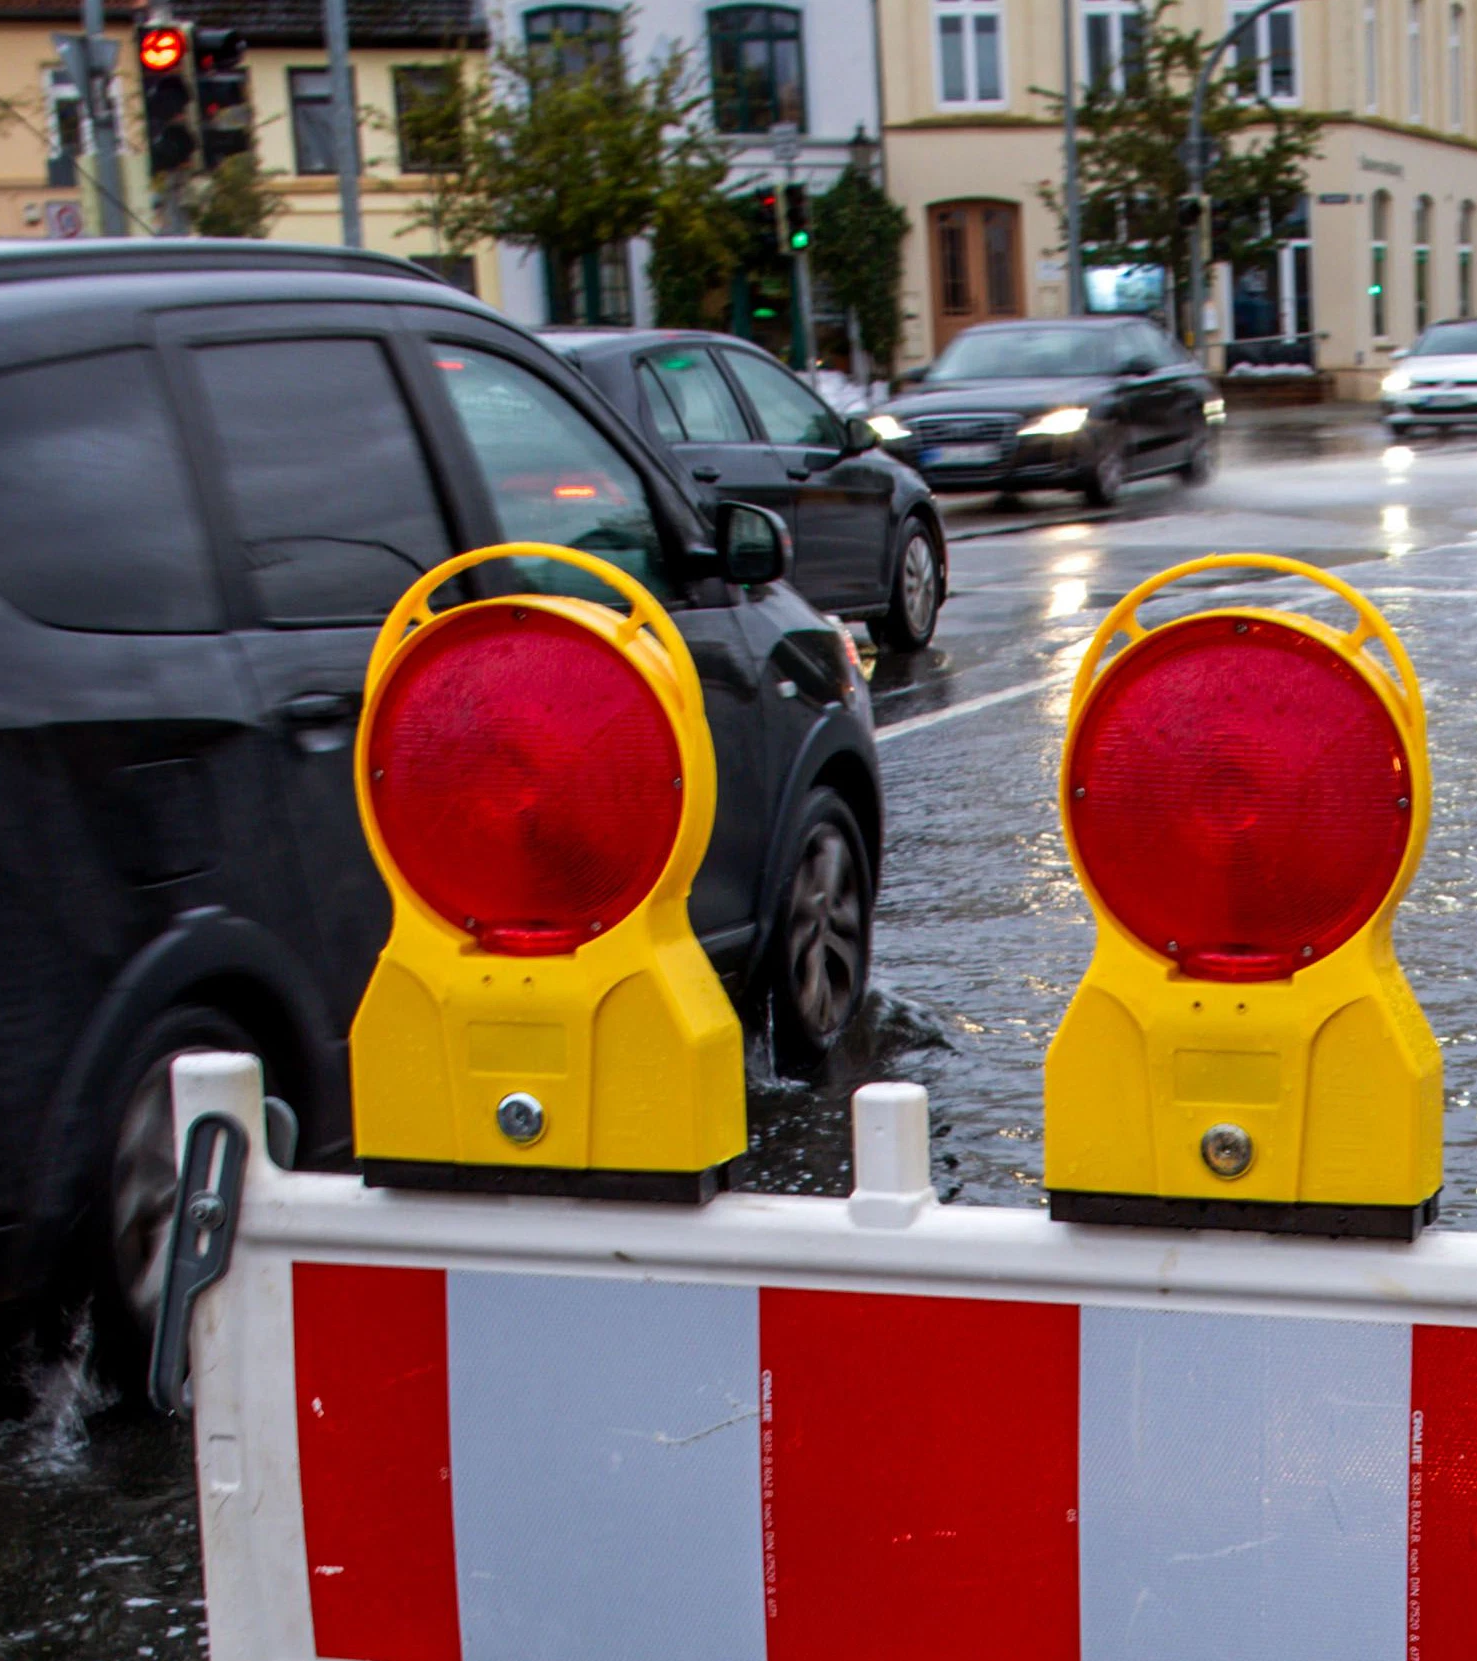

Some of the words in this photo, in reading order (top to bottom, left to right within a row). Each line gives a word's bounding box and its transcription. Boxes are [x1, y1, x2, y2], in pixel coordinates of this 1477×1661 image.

[1410, 1410, 1424, 1464] ORALITE
[764, 1530, 774, 1552] DIN
[1410, 1548, 1420, 1574] nach
[1410, 1576, 1420, 1596] DIN
[1410, 1600, 1420, 1630] 67520
